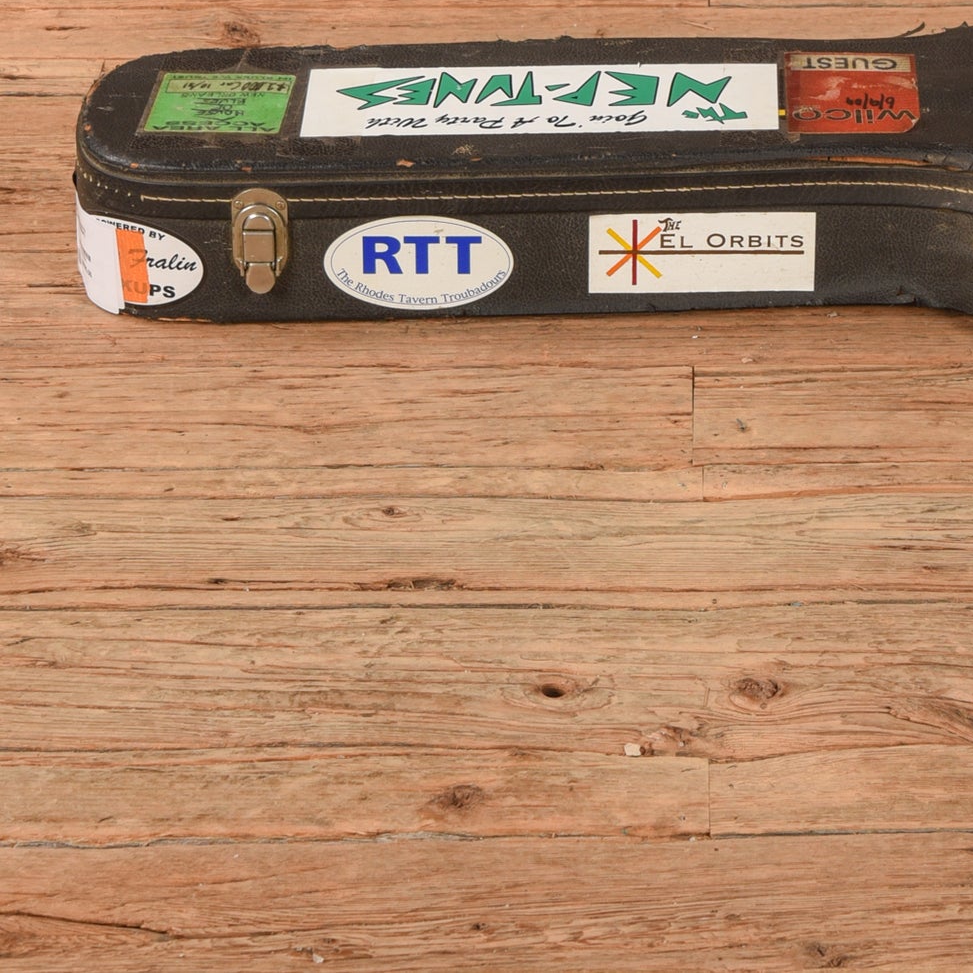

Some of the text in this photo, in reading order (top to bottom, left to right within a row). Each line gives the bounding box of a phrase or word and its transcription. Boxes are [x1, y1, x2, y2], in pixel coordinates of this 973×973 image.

[802, 57, 897, 70] GUEST
[366, 117, 429, 130] With
[435, 114, 505, 131] Party
[510, 116, 539, 130] A
[545, 116, 576, 128] To
[148, 229, 166, 241] BY
[361, 235, 483, 275] RTT
[336, 267, 507, 305] The Rhodes Tavern Troubadours
